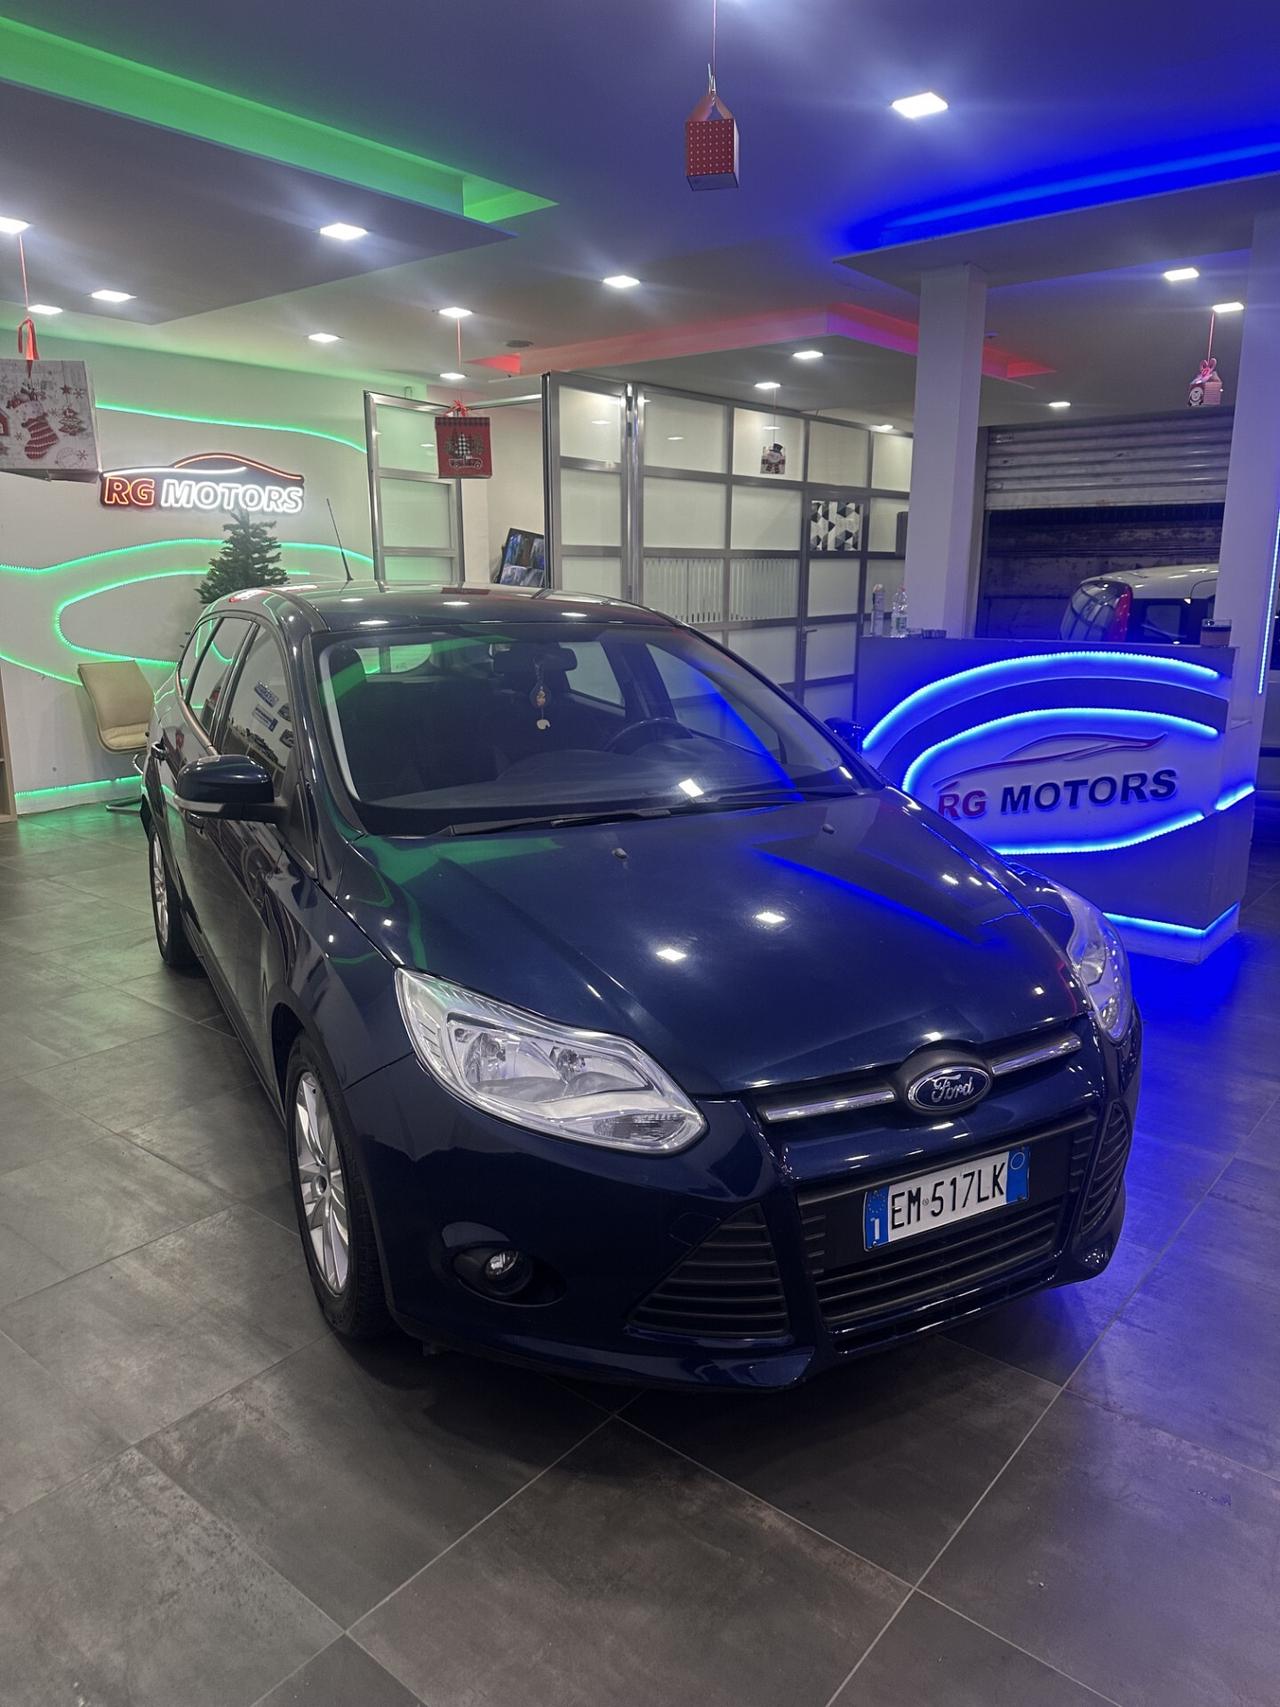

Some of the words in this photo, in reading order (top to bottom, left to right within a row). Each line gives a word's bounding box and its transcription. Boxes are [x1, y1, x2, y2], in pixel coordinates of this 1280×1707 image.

[104, 476, 155, 507] RG
[161, 478, 304, 513] MOTORS
[937, 789, 987, 820] RG
[1000, 768, 1177, 815] MOTORS
[931, 1073, 974, 1103] Ford
[891, 1186, 922, 1231] EM
[930, 1161, 1006, 1218] 517LK
